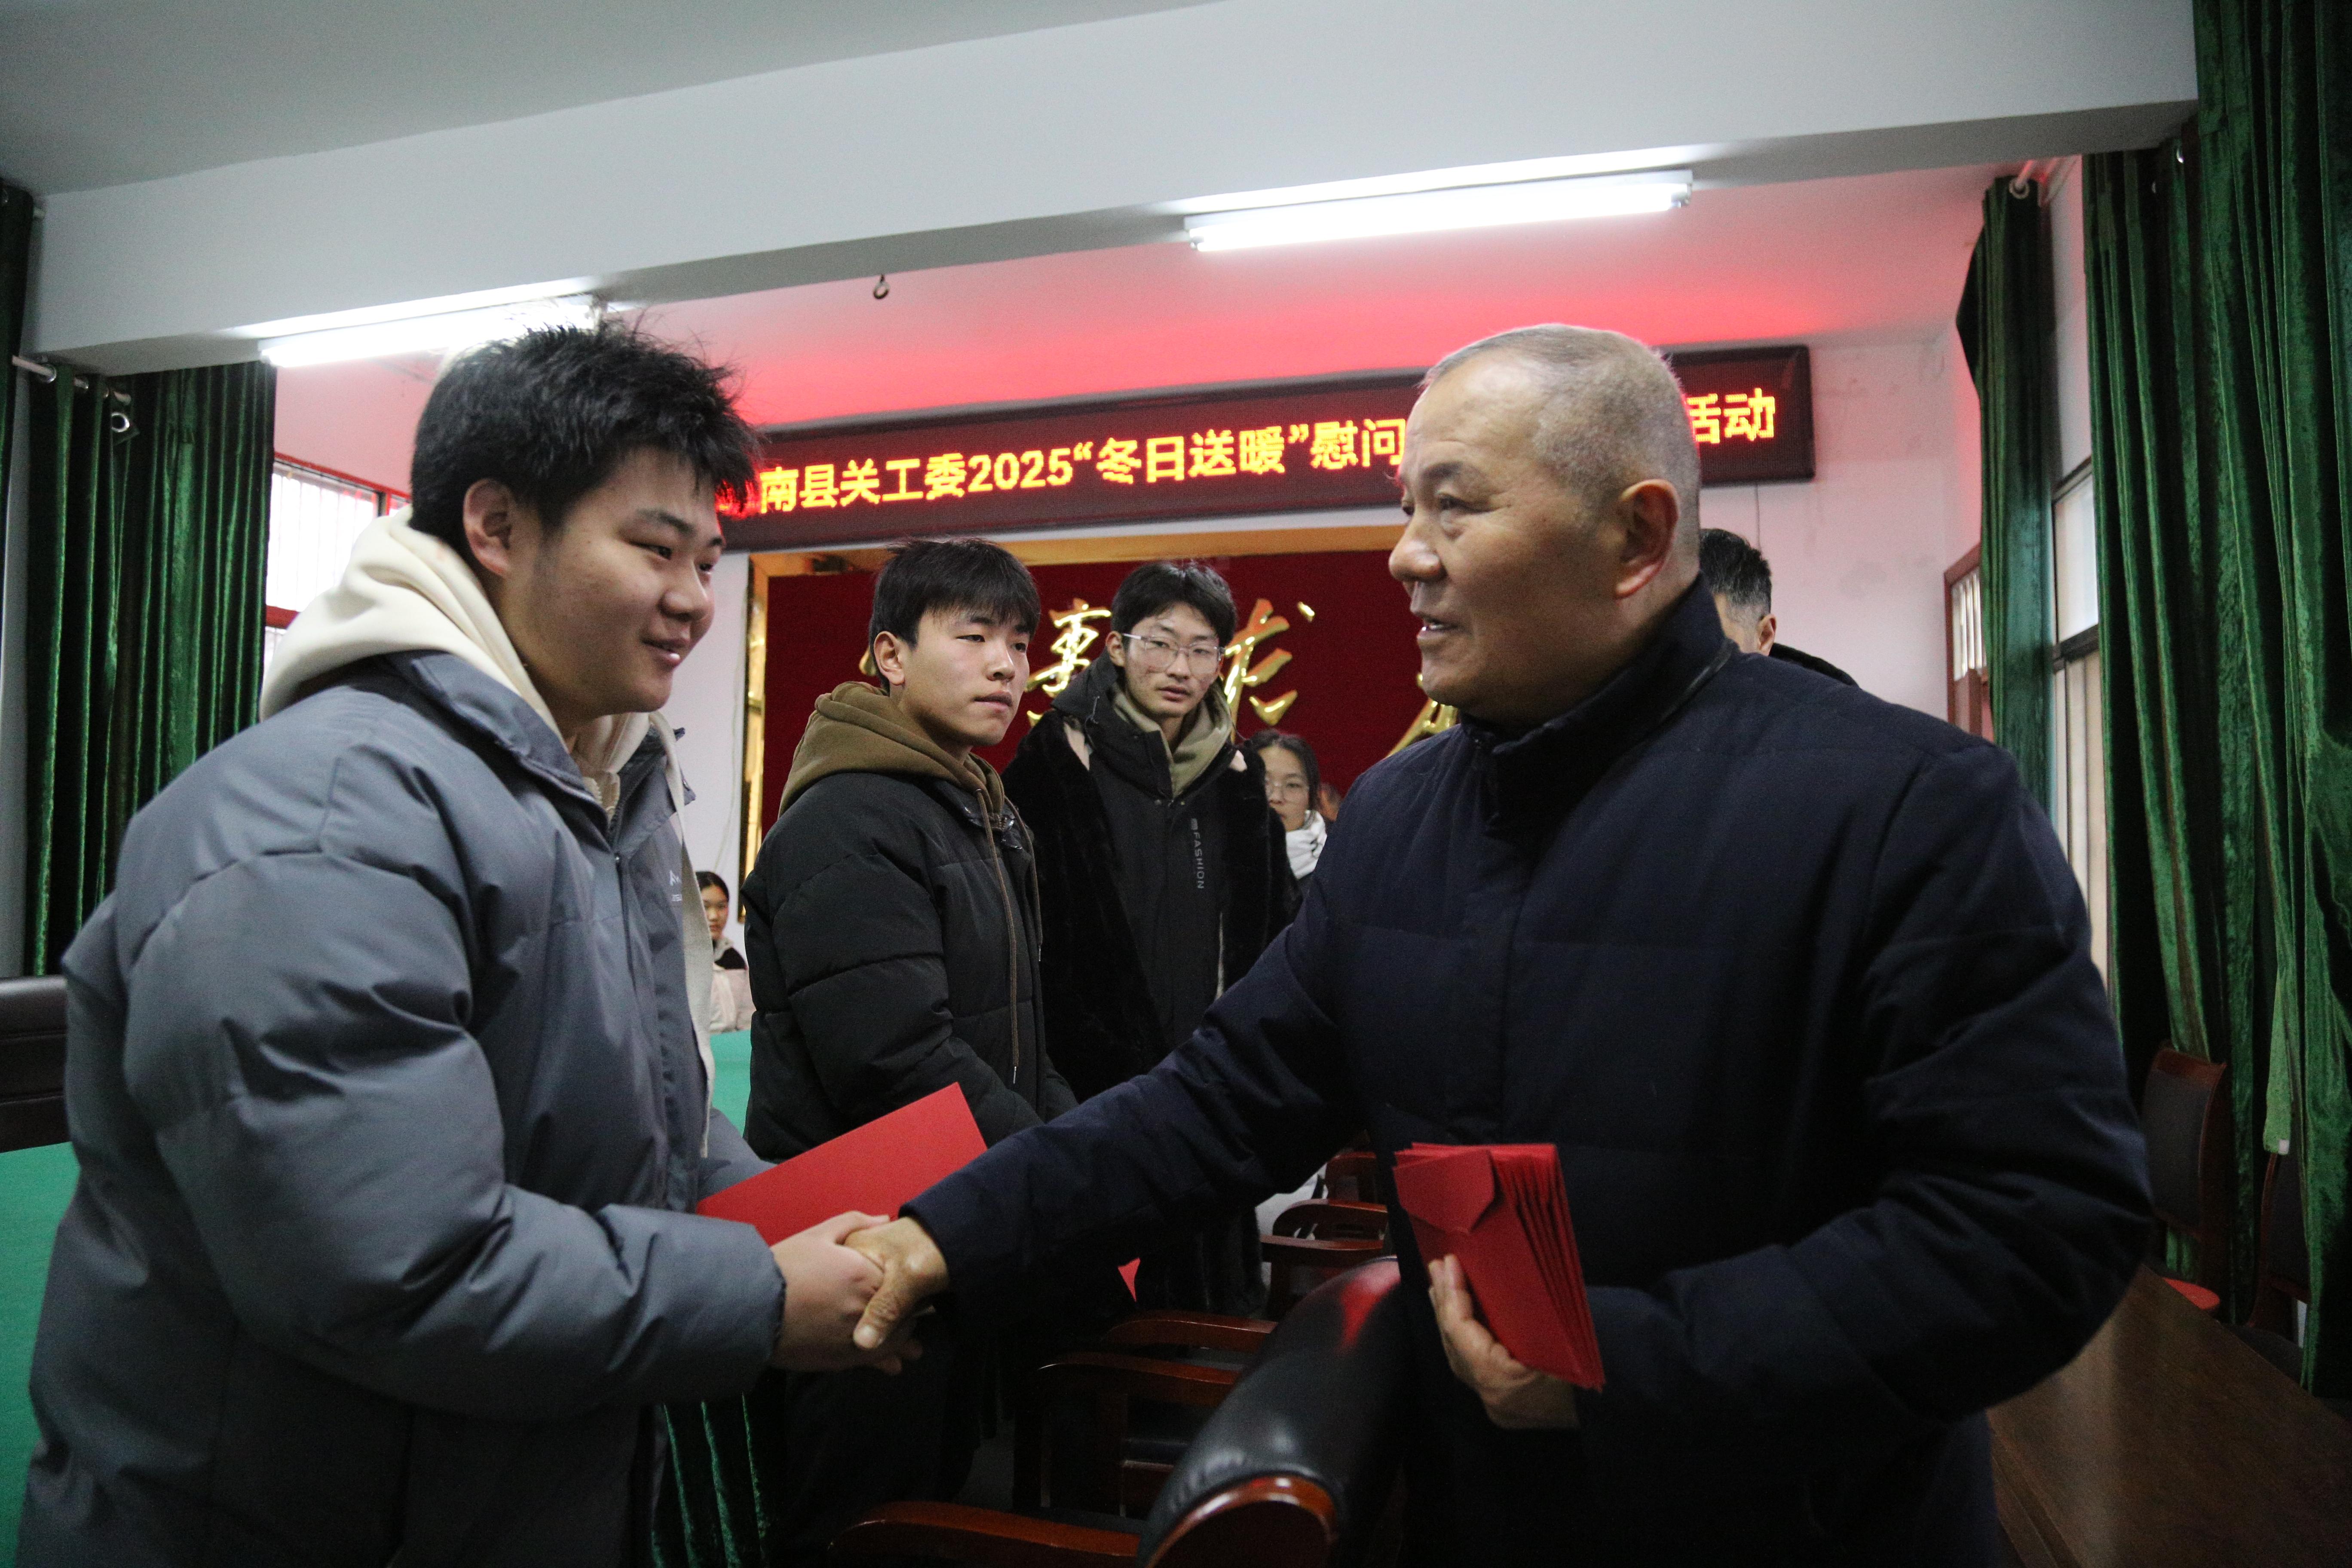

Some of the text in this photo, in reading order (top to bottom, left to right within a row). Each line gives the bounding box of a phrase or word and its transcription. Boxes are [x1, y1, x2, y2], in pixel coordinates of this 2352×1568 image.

[717, 418, 1406, 514] 南县关工委2025“冬日送暖”慰问
[1193, 832, 1204, 888] FASHION
